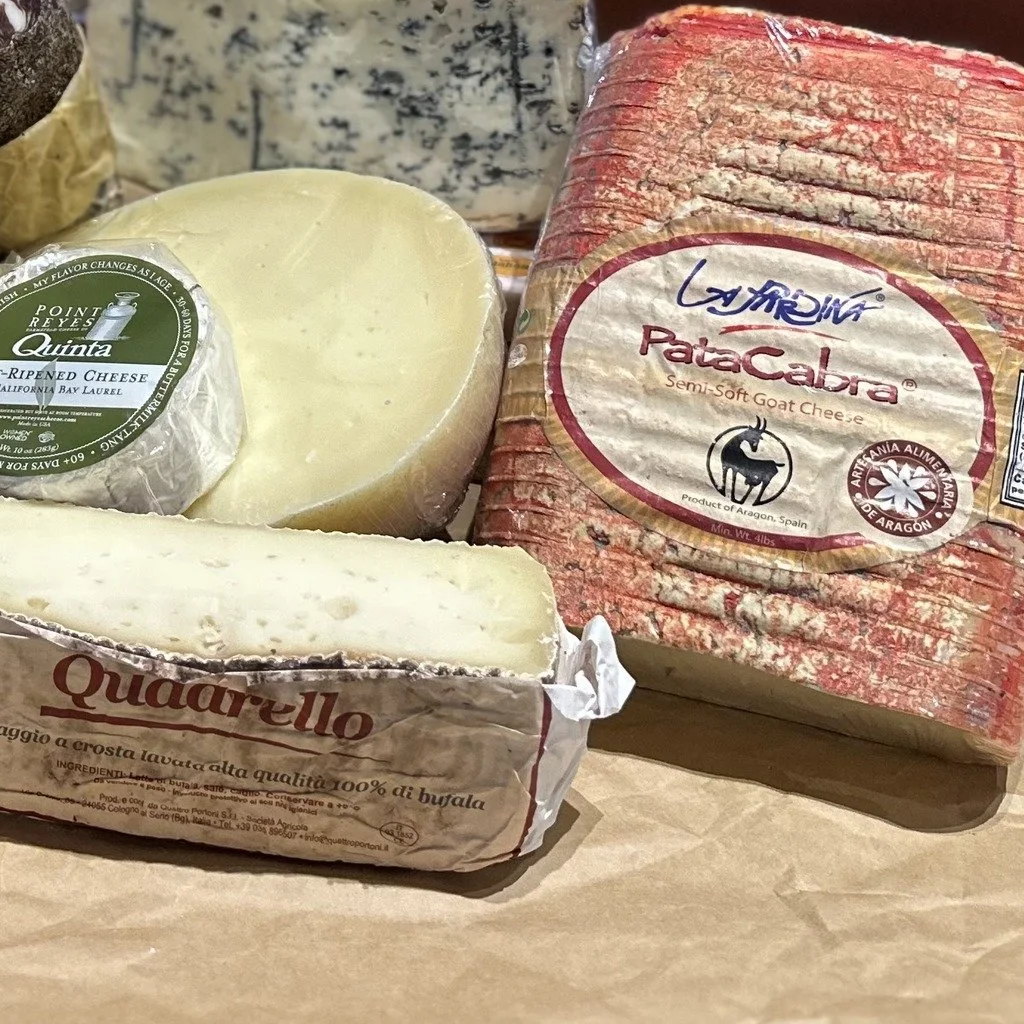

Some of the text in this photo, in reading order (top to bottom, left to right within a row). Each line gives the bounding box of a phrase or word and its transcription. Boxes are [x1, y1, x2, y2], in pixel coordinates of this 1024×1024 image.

[33, 278, 49, 289] MY
[51, 263, 88, 281] FLAVOR
[90, 261, 137, 273] CHANGES
[139, 267, 150, 277] AS
[153, 275, 173, 291] AGE
[35, 304, 102, 317] POINT
[28, 317, 95, 328] REYES
[183, 318, 192, 339] DAYS
[12, 333, 113, 358] Quinta
[178, 340, 191, 359] FOR
[173, 361, 183, 371] A
[129, 366, 179, 431] BUTTERMILK
[666, 375, 864, 426] Semi-Soft Goat Cheese
[100, 426, 133, 453] TANG
[13, 446, 23, 454] 10
[64, 451, 85, 466] 60+
[6, 462, 28, 471] FOR
[31, 458, 60, 470] DAYS
[904, 444, 956, 510] ALIMENTARIA
[681, 493, 721, 510] Product
[723, 504, 735, 512] of
[779, 516, 808, 529] Spain
[860, 504, 878, 519] DE
[754, 534, 776, 547] 4lbs
[55, 737, 69, 749] a
[72, 738, 136, 761] crosta
[141, 749, 205, 773] lavata
[208, 760, 248, 779] alta
[253, 766, 327, 792] qualità
[330, 778, 388, 796] 100%
[392, 784, 414, 800] di
[418, 790, 486, 812] bufala
